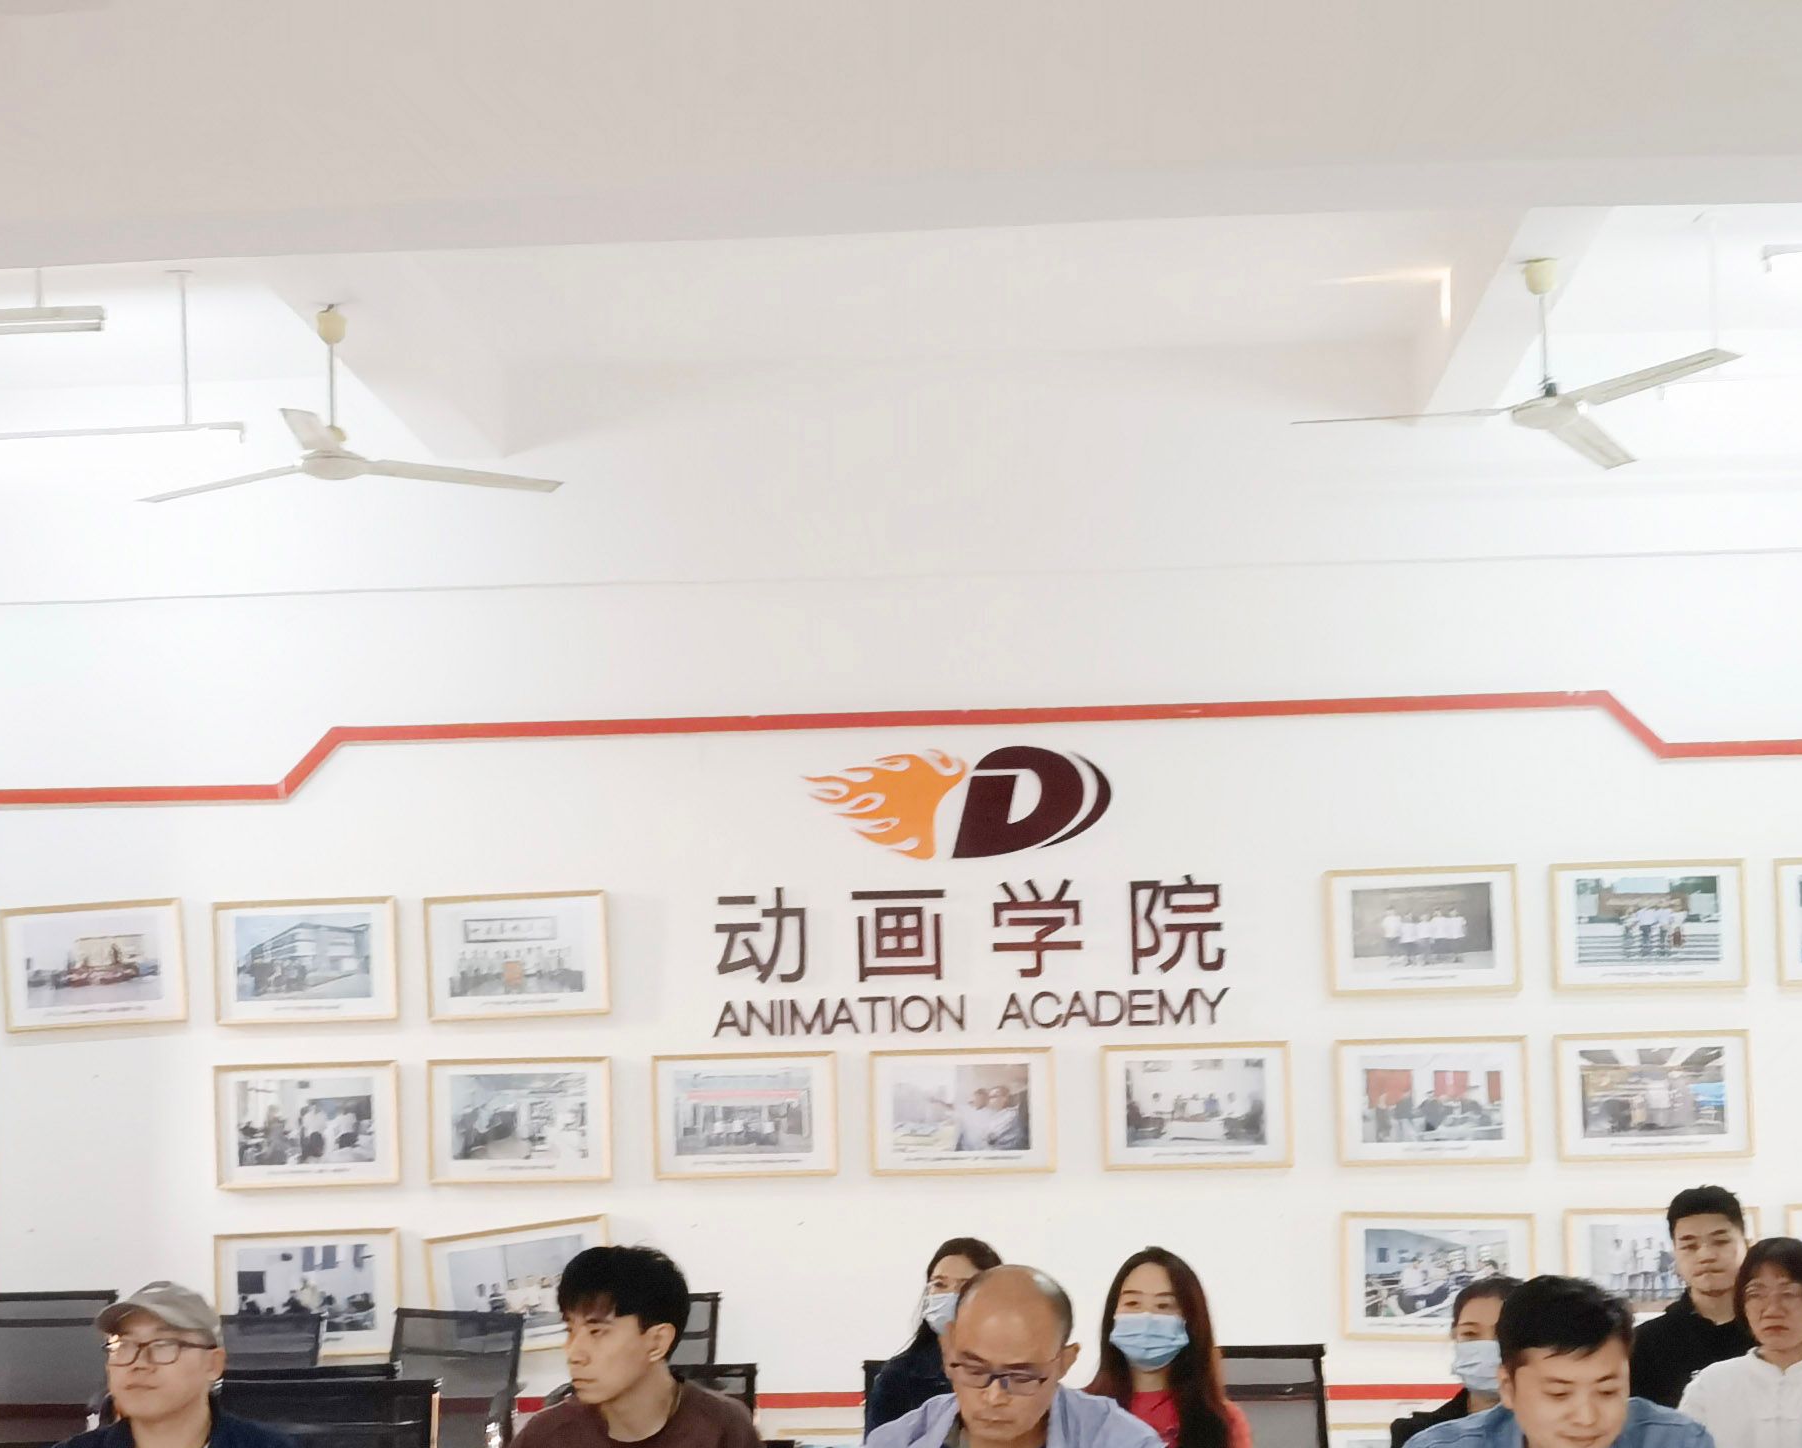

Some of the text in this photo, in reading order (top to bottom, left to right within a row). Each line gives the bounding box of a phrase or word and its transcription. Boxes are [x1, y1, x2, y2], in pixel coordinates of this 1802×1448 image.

[714, 874, 1226, 984] 动画学院
[713, 987, 1230, 1037] ANIMATION ACADEMY
